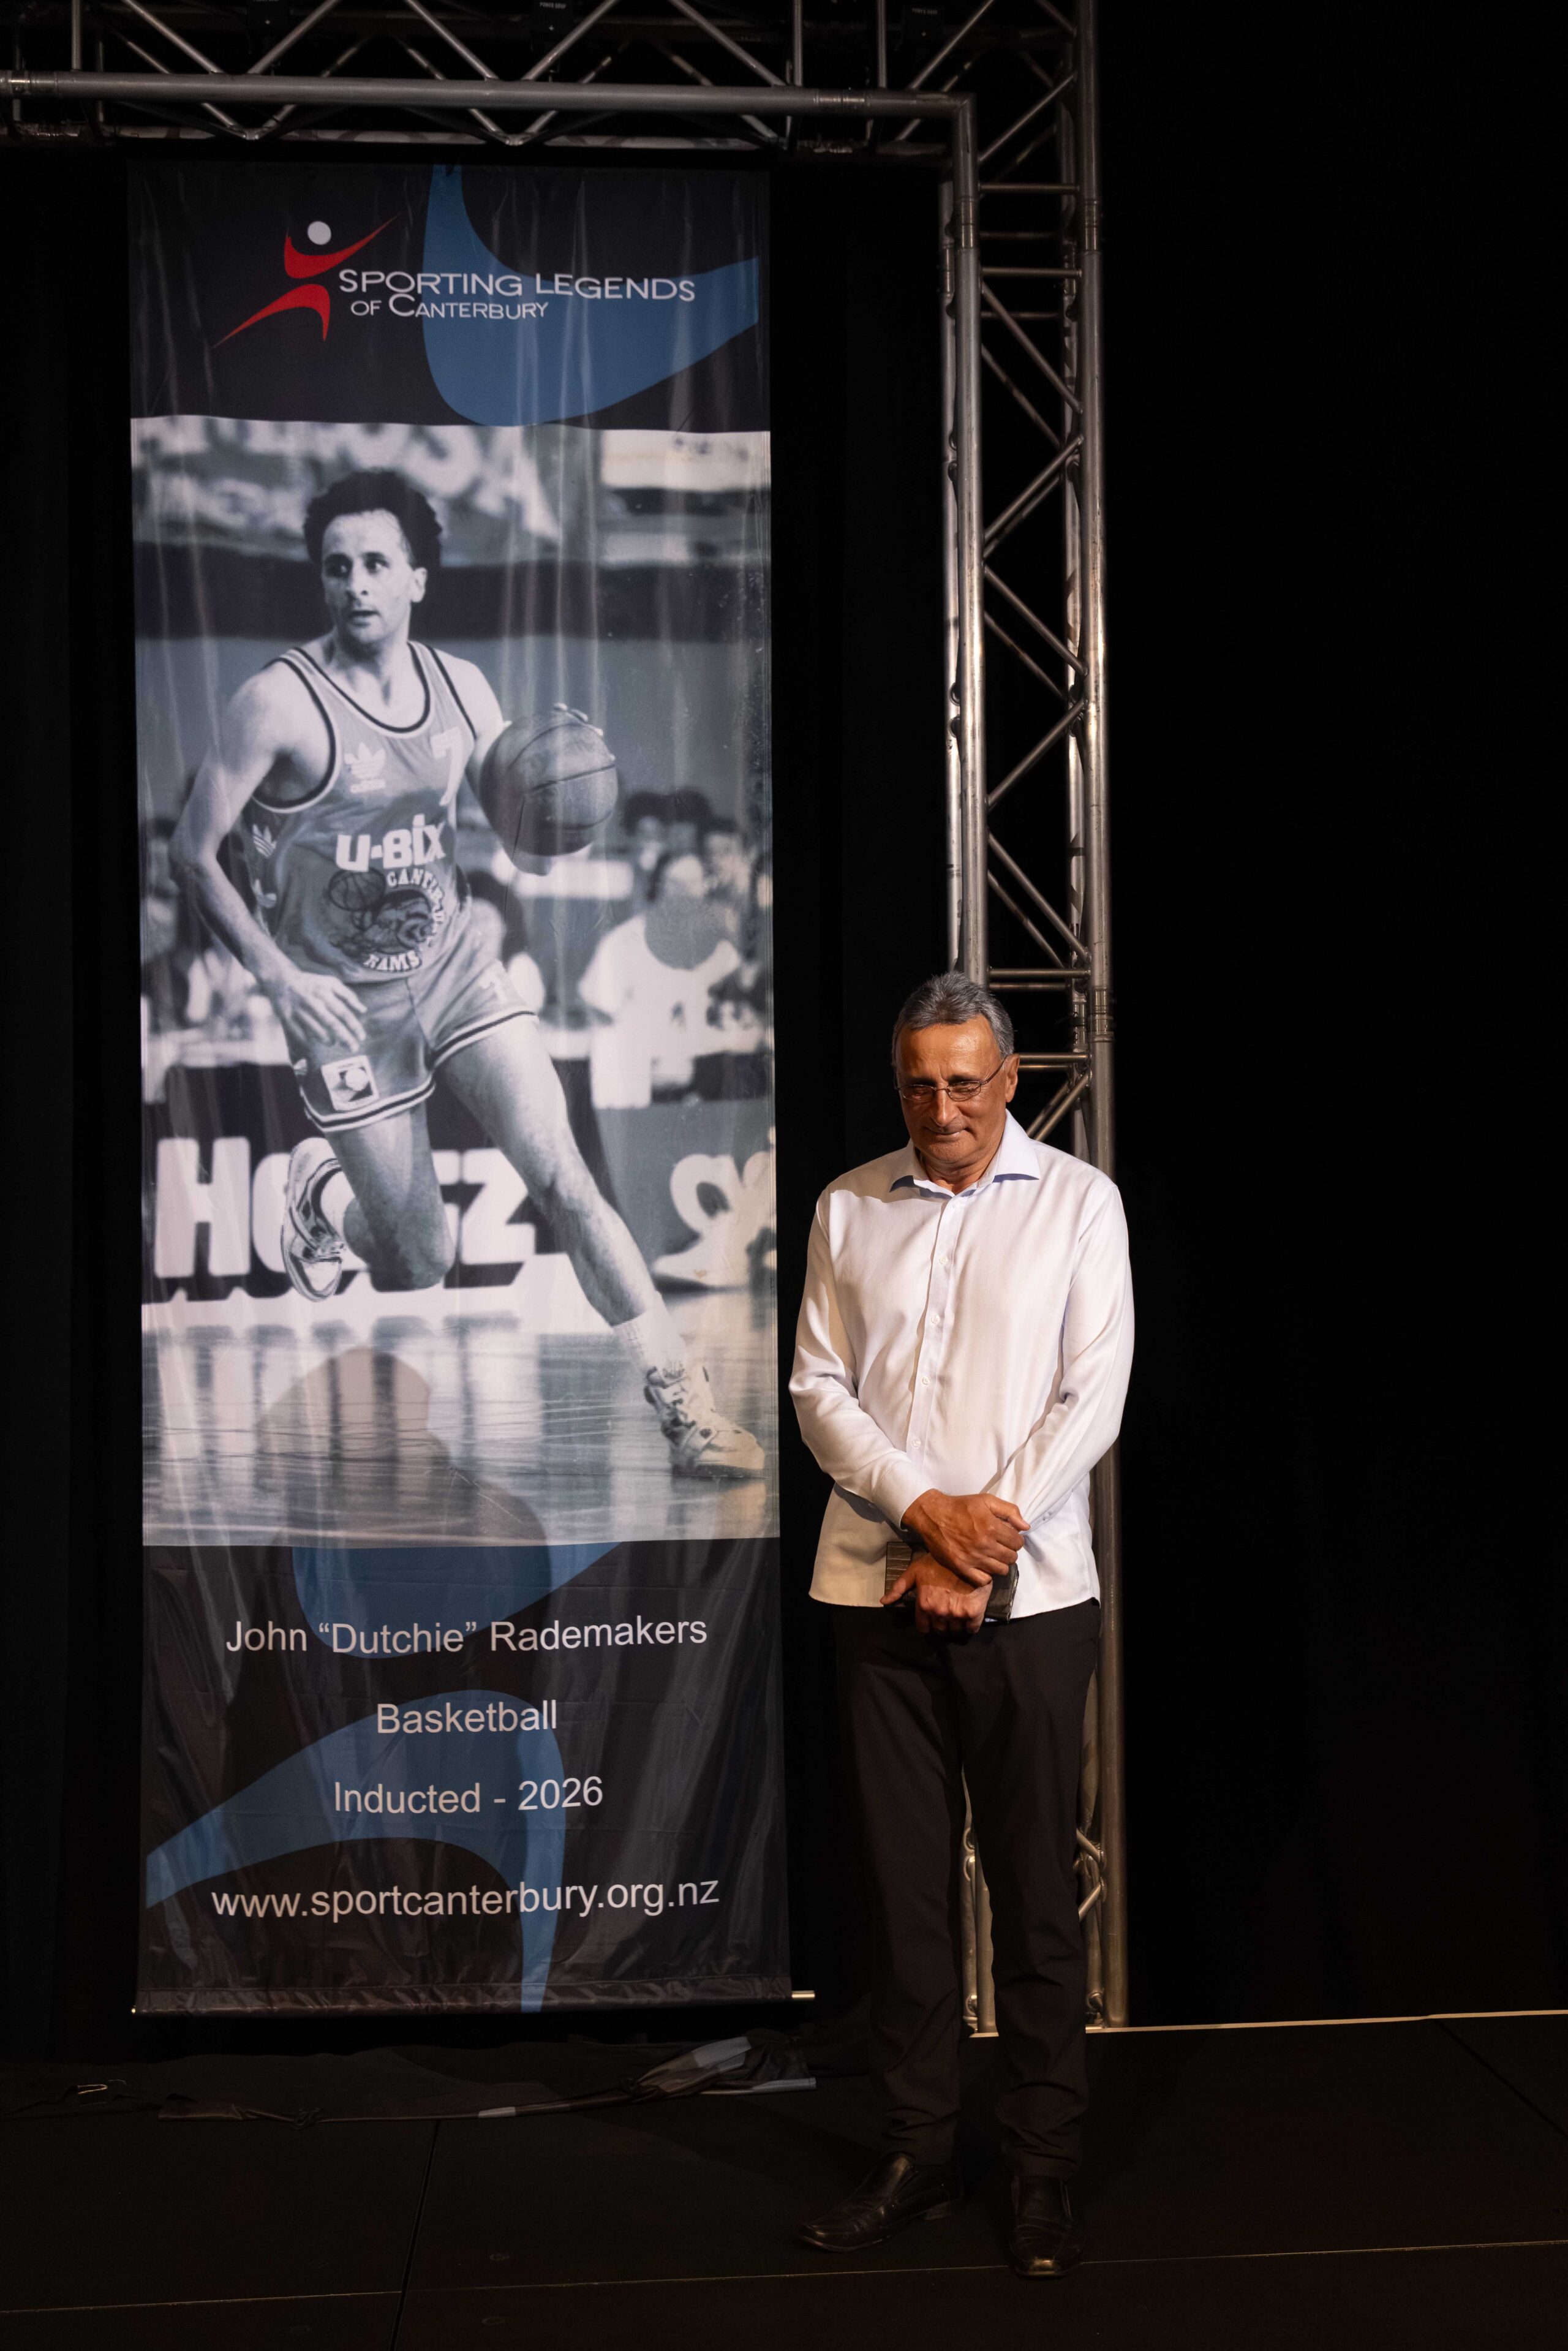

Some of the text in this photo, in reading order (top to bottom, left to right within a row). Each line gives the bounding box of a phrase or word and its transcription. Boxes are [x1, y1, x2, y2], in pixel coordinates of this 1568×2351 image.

[339, 269, 695, 301] SPORTING LEGENDS
[350, 292, 549, 320] OF CANTERBURY
[226, 1615, 707, 1654] John “Dutchie” Rademakers
[377, 1699, 557, 1734] Basketball
[334, 1781, 480, 1814] Inducted
[518, 1776, 603, 1811] 2026
[211, 1879, 720, 1923] www.sportcanterbury.org.nz
